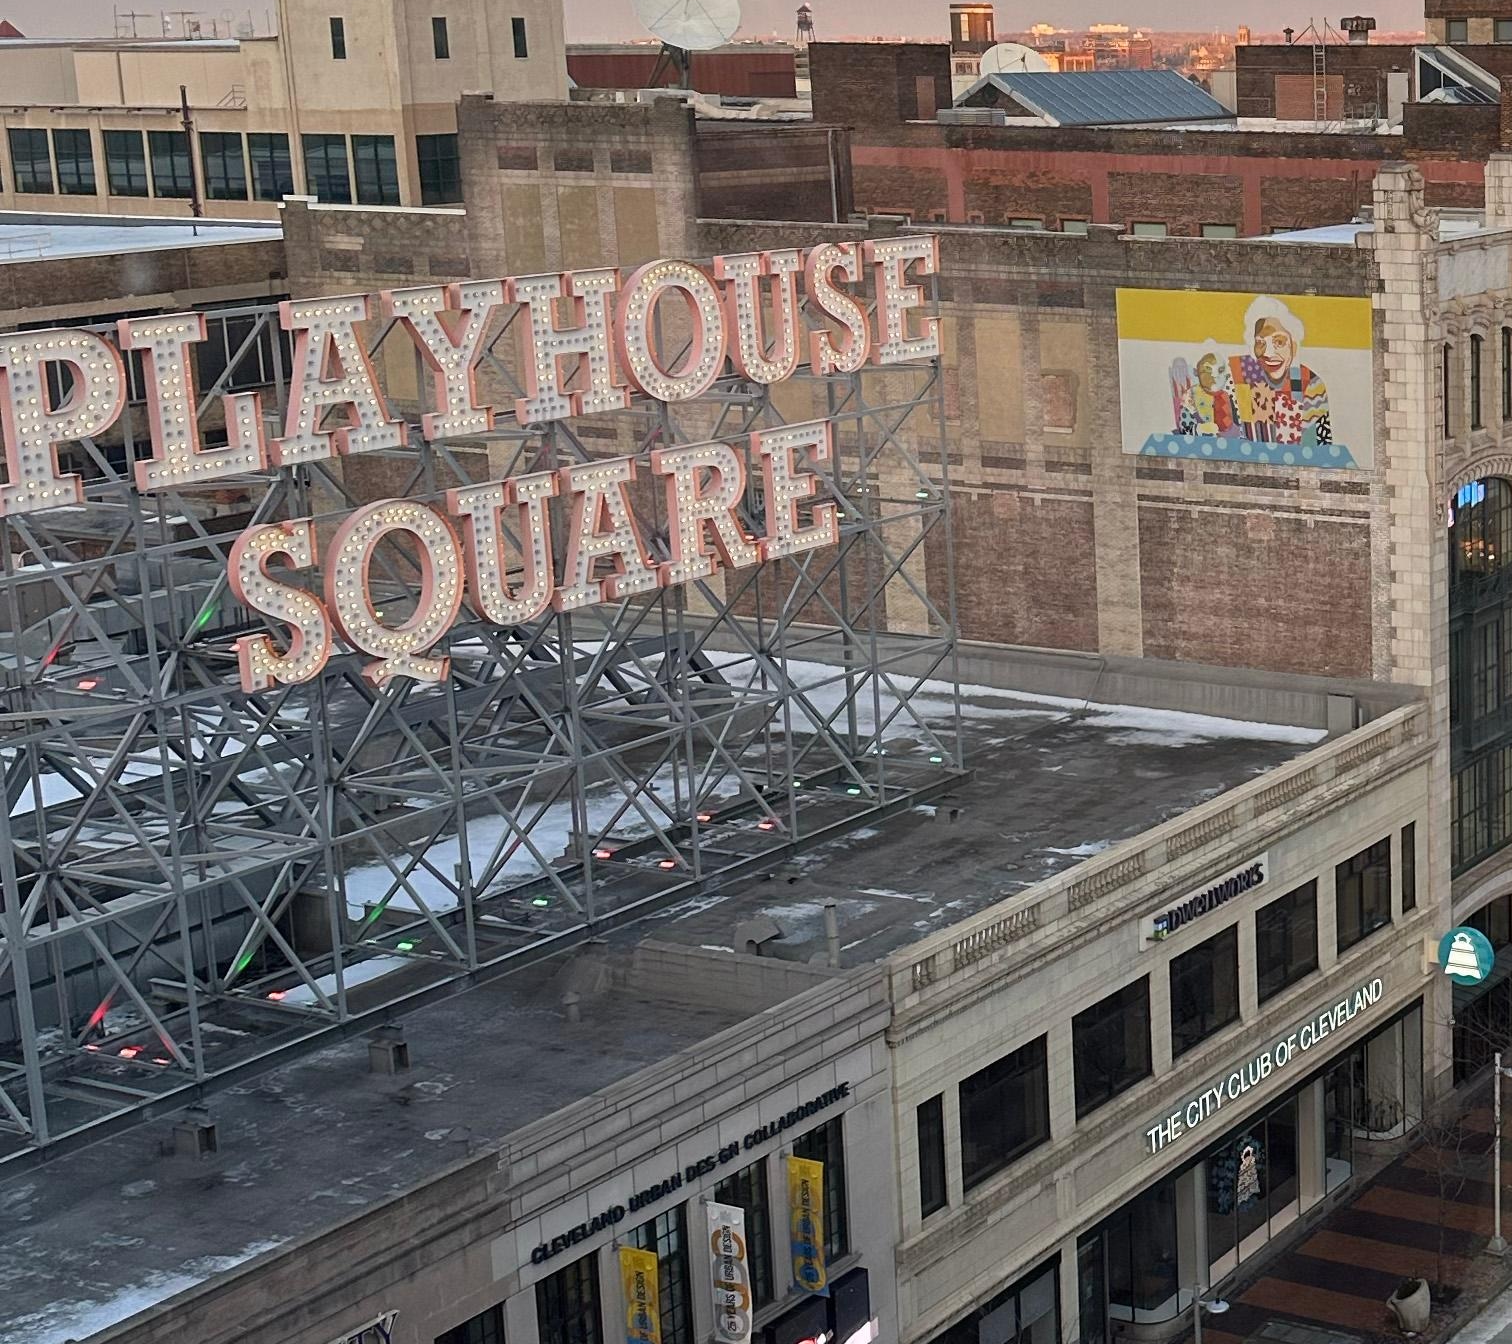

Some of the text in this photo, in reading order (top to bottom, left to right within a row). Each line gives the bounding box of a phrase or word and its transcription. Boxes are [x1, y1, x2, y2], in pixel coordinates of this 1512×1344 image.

[0, 234, 944, 517] PLAYHOUSE
[230, 418, 840, 695] SQUARE
[531, 1081, 851, 1265] CLEVELAND URBAN DESGN COLLABORATIVE
[1147, 978, 1383, 1154] THE CITY CLUB OF CLEVELAND
